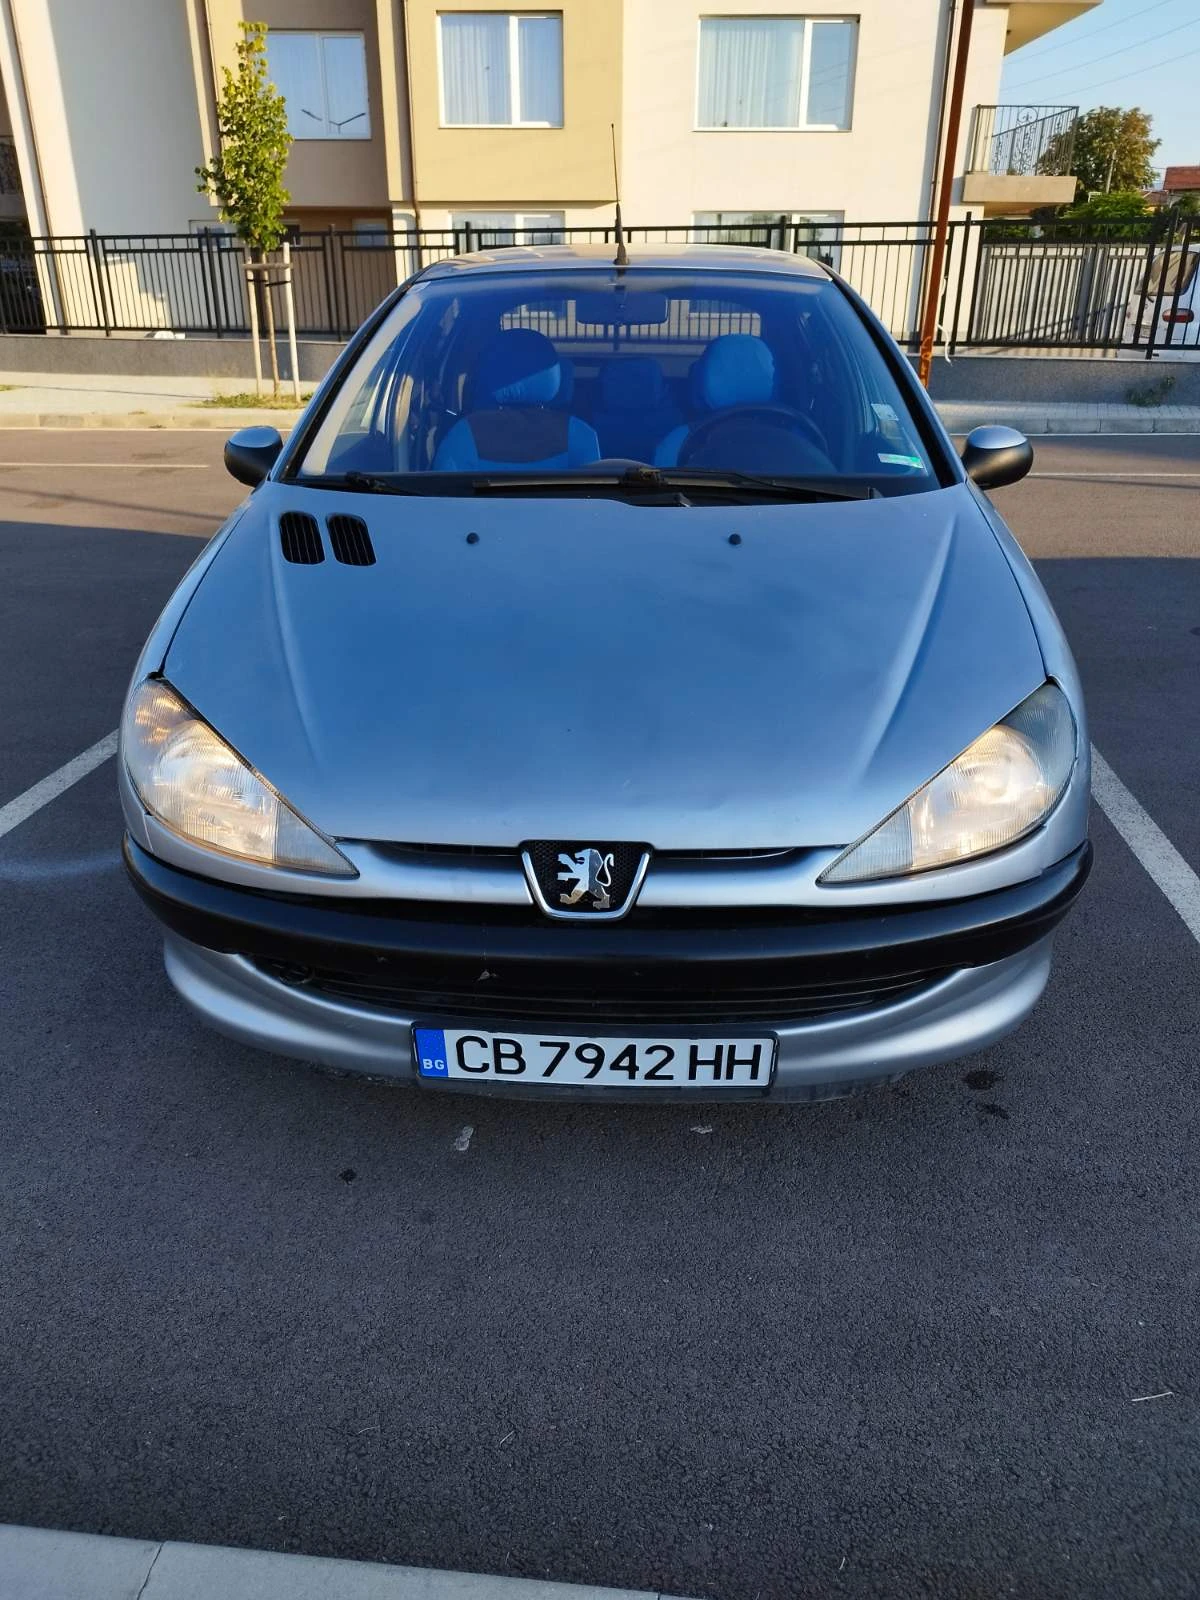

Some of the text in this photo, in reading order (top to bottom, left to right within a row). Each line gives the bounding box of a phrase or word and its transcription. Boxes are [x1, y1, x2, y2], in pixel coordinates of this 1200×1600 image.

[422, 1058, 445, 1071] BG
[455, 1035, 763, 1081] CB 7942 HH
